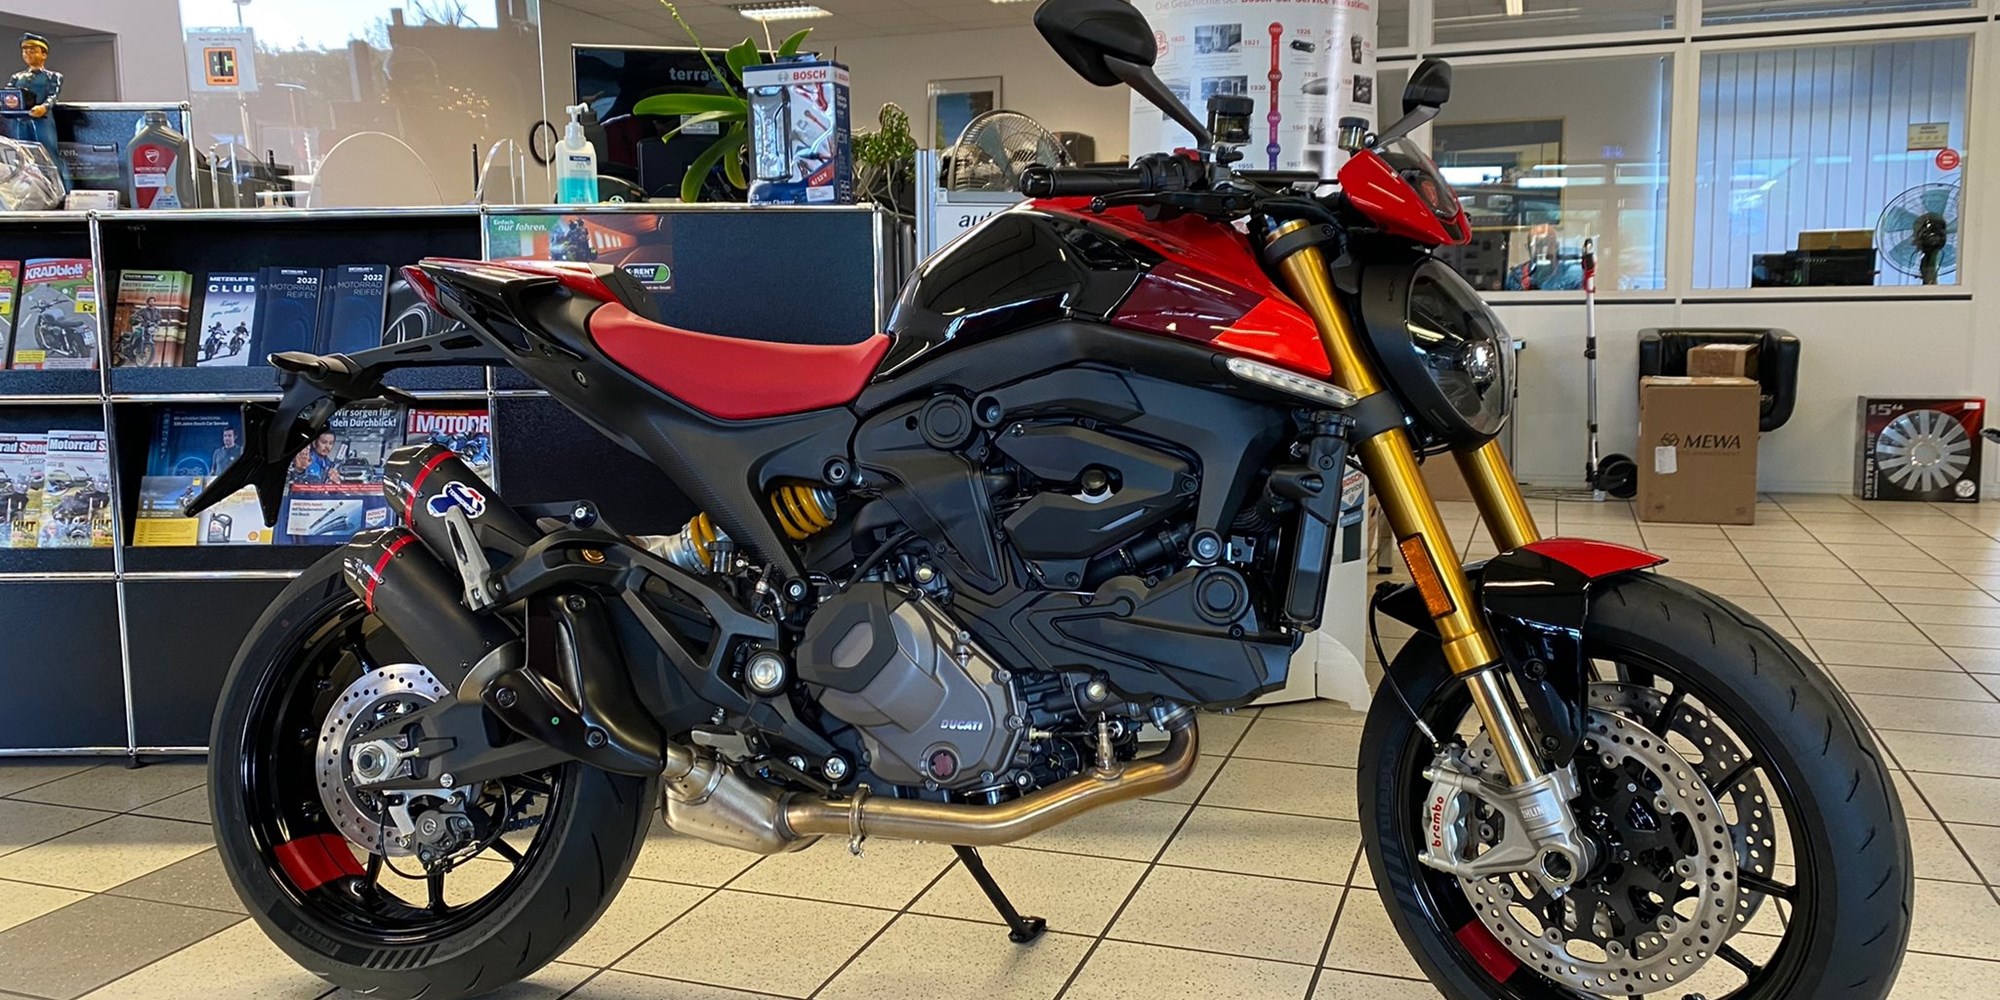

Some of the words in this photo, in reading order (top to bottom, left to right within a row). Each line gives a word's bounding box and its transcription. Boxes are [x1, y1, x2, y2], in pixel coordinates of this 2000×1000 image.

[669, 67, 709, 81] terra
[793, 70, 826, 80] BOSCH
[515, 222, 547, 232] fahren.
[25, 263, 83, 280] KRADblatt
[270, 283, 317, 291] MOTORRAD
[338, 281, 382, 289] MOTORRAD
[286, 290, 316, 299] REIFEN
[353, 288, 381, 296] REIFEN
[349, 409, 378, 419] sorgen
[379, 407, 391, 416] für
[333, 418, 348, 427] den
[350, 418, 397, 427] Durchblick!
[49, 439, 97, 451] Motorrad
[1683, 434, 1742, 449] MEWA
[940, 719, 983, 731] DUCATI
[1431, 796, 1445, 848] brembo
